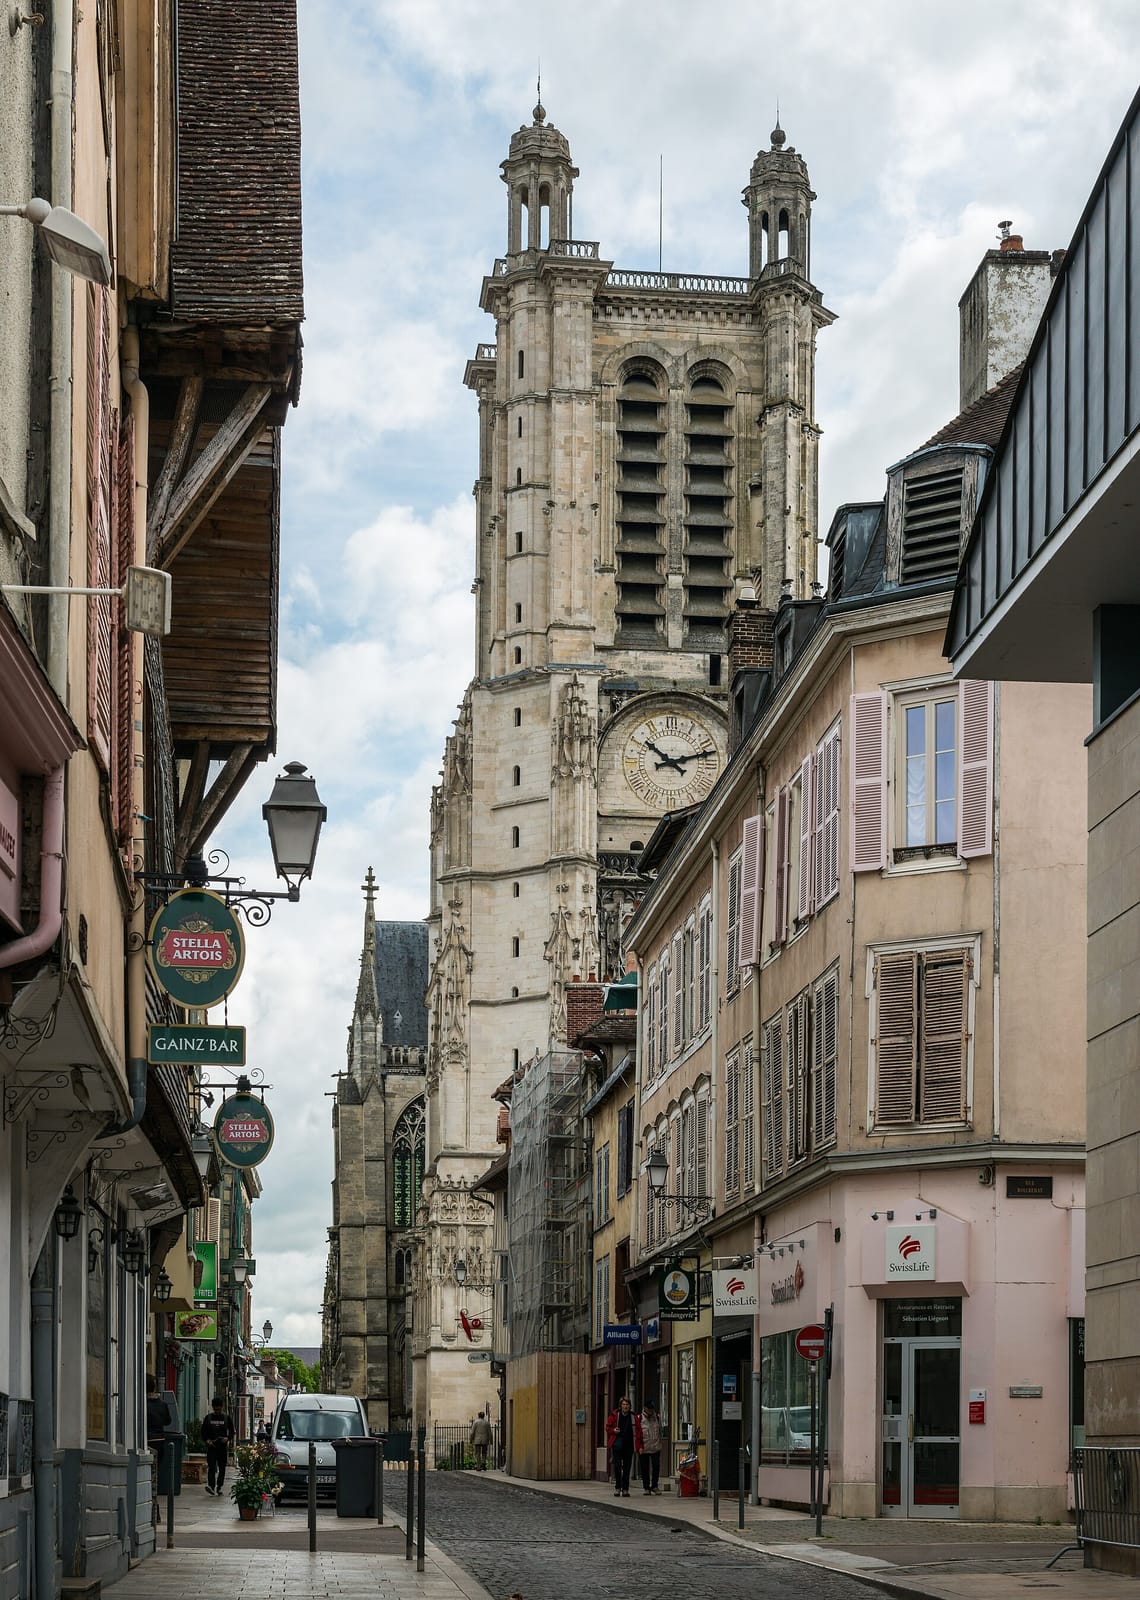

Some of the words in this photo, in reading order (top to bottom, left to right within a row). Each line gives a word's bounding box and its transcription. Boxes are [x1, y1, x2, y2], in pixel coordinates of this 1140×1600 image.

[173, 937, 221, 949] STELLA
[173, 950, 222, 961] ARTOIS
[228, 1123, 260, 1131] STELLA
[660, 1311, 695, 1320] Boulangerie
[606, 1331, 630, 1339] Allianz
